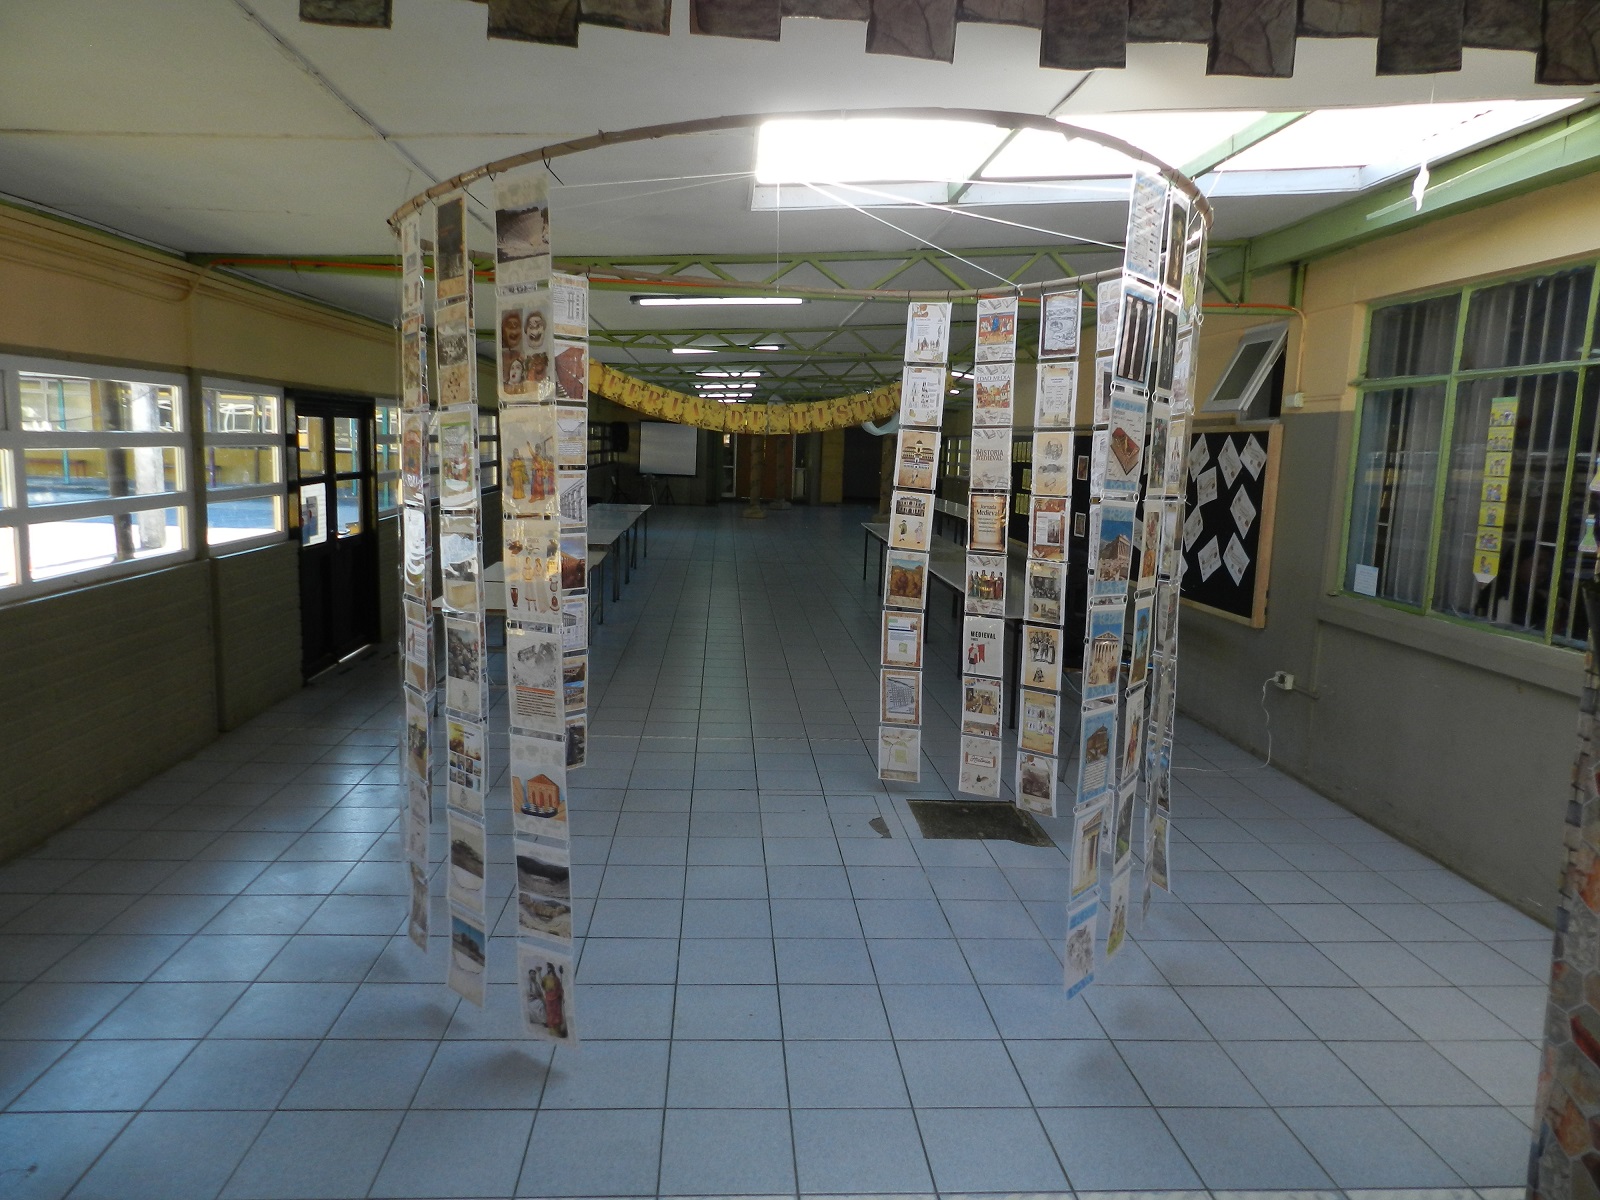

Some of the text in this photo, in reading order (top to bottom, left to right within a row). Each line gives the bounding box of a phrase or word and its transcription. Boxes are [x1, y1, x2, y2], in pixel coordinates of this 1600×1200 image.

[607, 374, 701, 417] FERIA
[730, 410, 764, 426] DE
[970, 631, 996, 640] MEDIEVAL
